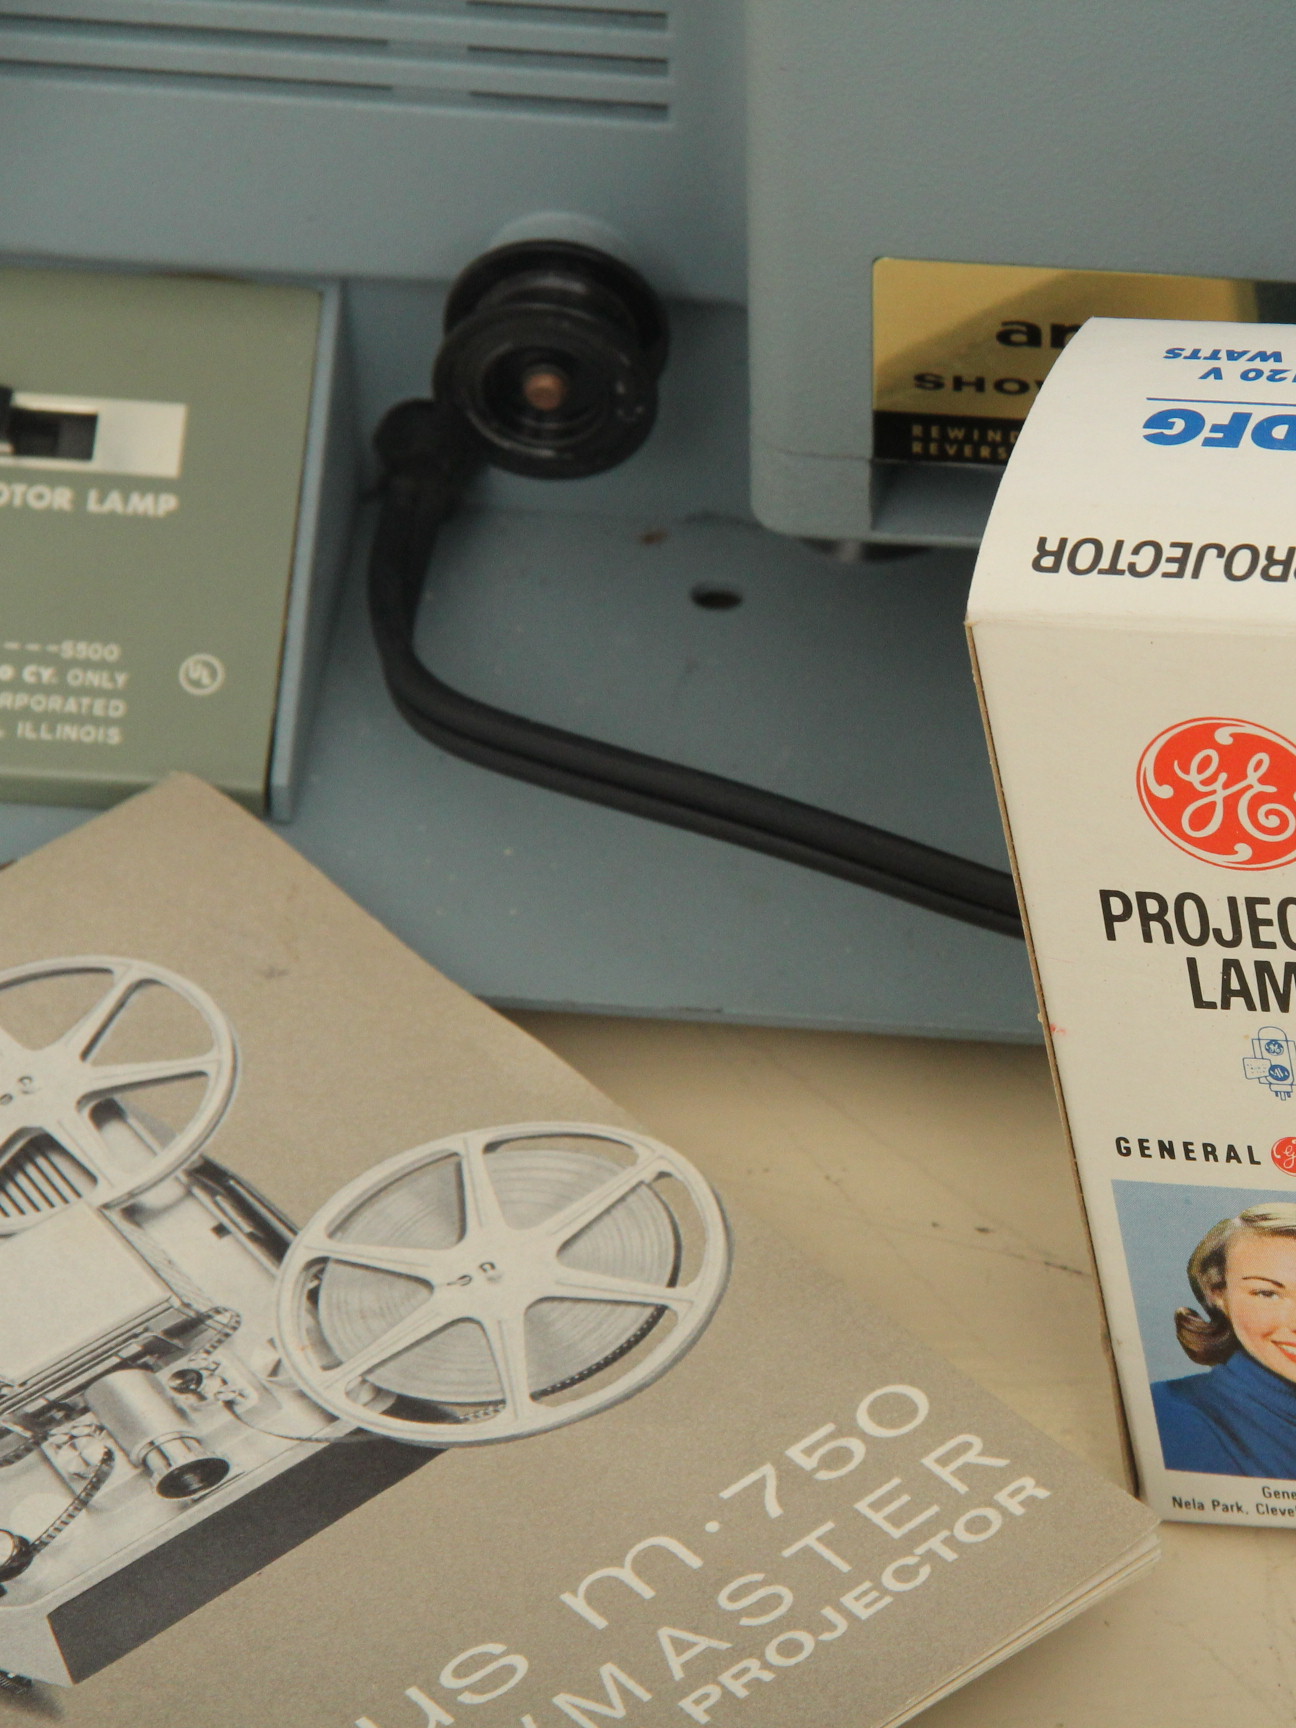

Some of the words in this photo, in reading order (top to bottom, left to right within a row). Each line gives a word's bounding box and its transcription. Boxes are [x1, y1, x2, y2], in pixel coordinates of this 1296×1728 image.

[1163, 347, 1283, 364] WATTS
[913, 372, 1044, 396] SHO
[1198, 366, 1224, 381] V
[86, 488, 180, 518] LAMP
[66, 667, 130, 690] ONLY
[17, 720, 123, 745] ILLINOIS
[1115, 1136, 1262, 1166] GENERAL
[1171, 1496, 1206, 1512] Nela
[521, 1434, 1011, 1728] MASTER
[677, 1476, 1052, 1725] PROJECTOR
